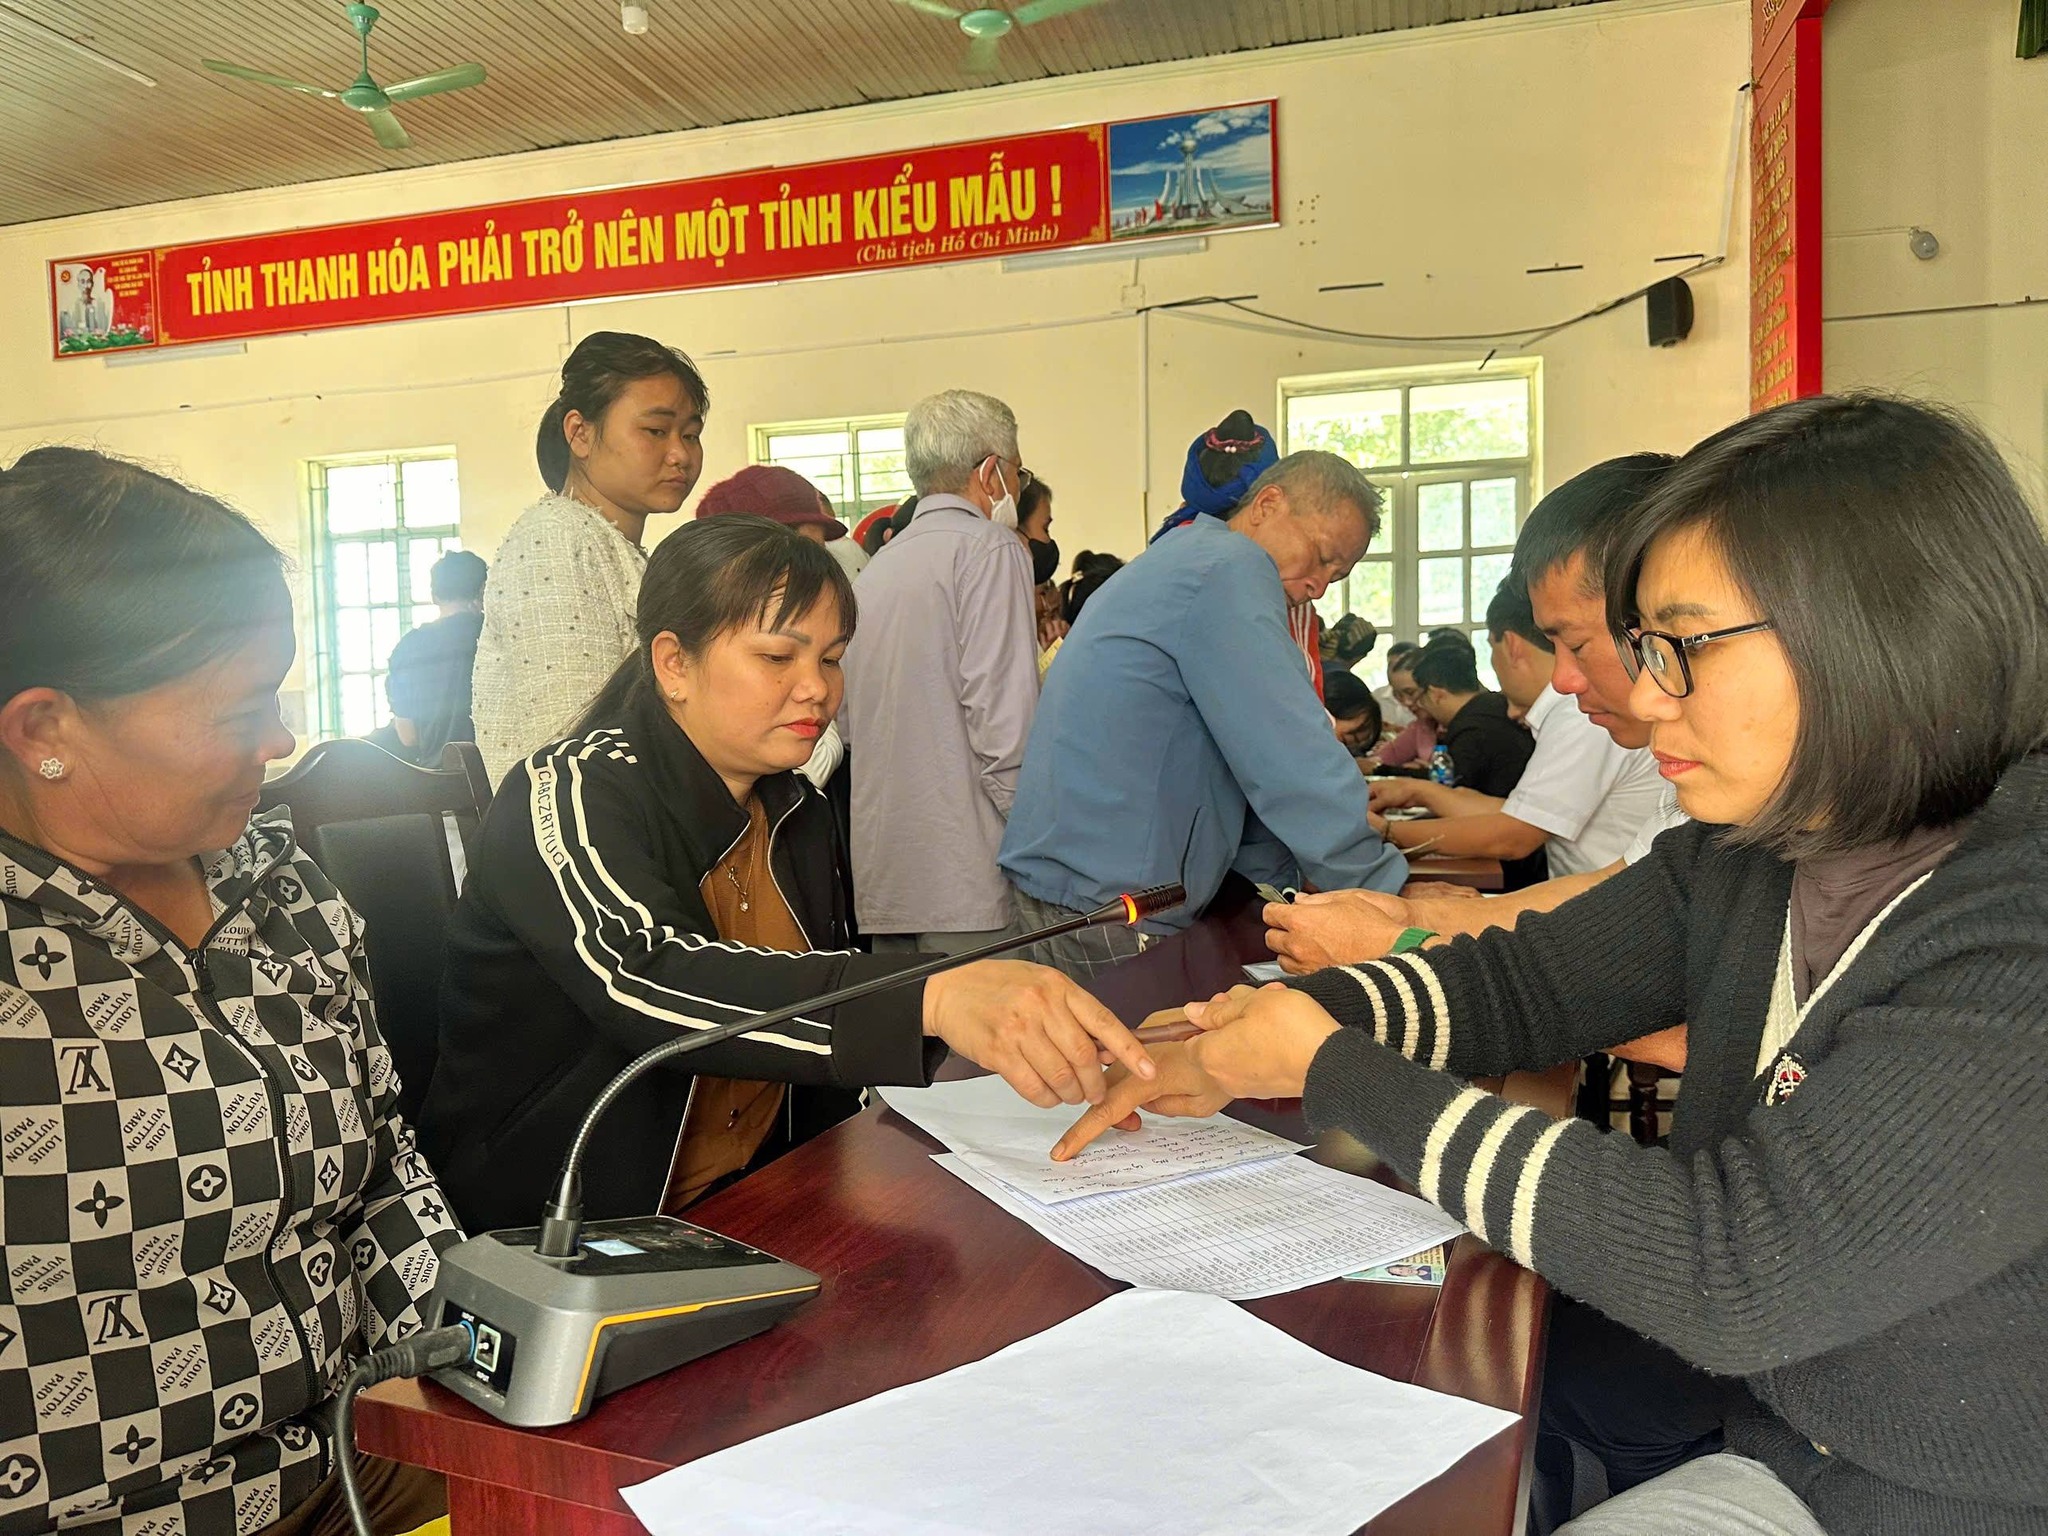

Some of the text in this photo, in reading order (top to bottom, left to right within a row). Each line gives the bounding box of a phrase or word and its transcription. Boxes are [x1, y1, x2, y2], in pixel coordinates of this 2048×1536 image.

[187, 152, 1061, 316] TỈNH THANH HÓA PHẢI TRỞ NÊN MỘT TỈNH KIỂU MẪU !
[856, 223, 1059, 265] (Chủ tịch Hồ Chí Minh)
[86, 992, 111, 1018] PARD
[111, 1006, 137, 1034] LOUIS
[223, 1093, 246, 1119] PARD
[244, 1105, 268, 1134] LOUIS
[4, 1117, 36, 1143] PARD
[123, 1108, 147, 1134] PARD
[295, 1119, 311, 1143] PARD
[28, 1134, 63, 1165] LOUIS
[145, 1122, 171, 1152] LOUIS
[231, 1212, 257, 1237] PARD
[244, 1223, 273, 1250] LOUIS
[135, 1236, 160, 1263] PARD
[157, 1246, 180, 1276] LOUIS
[11, 1255, 42, 1278] PARD
[401, 1256, 415, 1281] PARD
[421, 1257, 437, 1284] LOUIS
[38, 1269, 71, 1293] LOUIS
[254, 1319, 275, 1346] PARD
[369, 1308, 377, 1335] LOUIS
[275, 1328, 294, 1359] LOUIS
[156, 1347, 182, 1375] PARD
[179, 1358, 207, 1389] LOUIS
[36, 1373, 65, 1400] PARD
[61, 1386, 93, 1418] LOUIS
[237, 1488, 260, 1516] PARD
[255, 1497, 279, 1529] LOUIS
